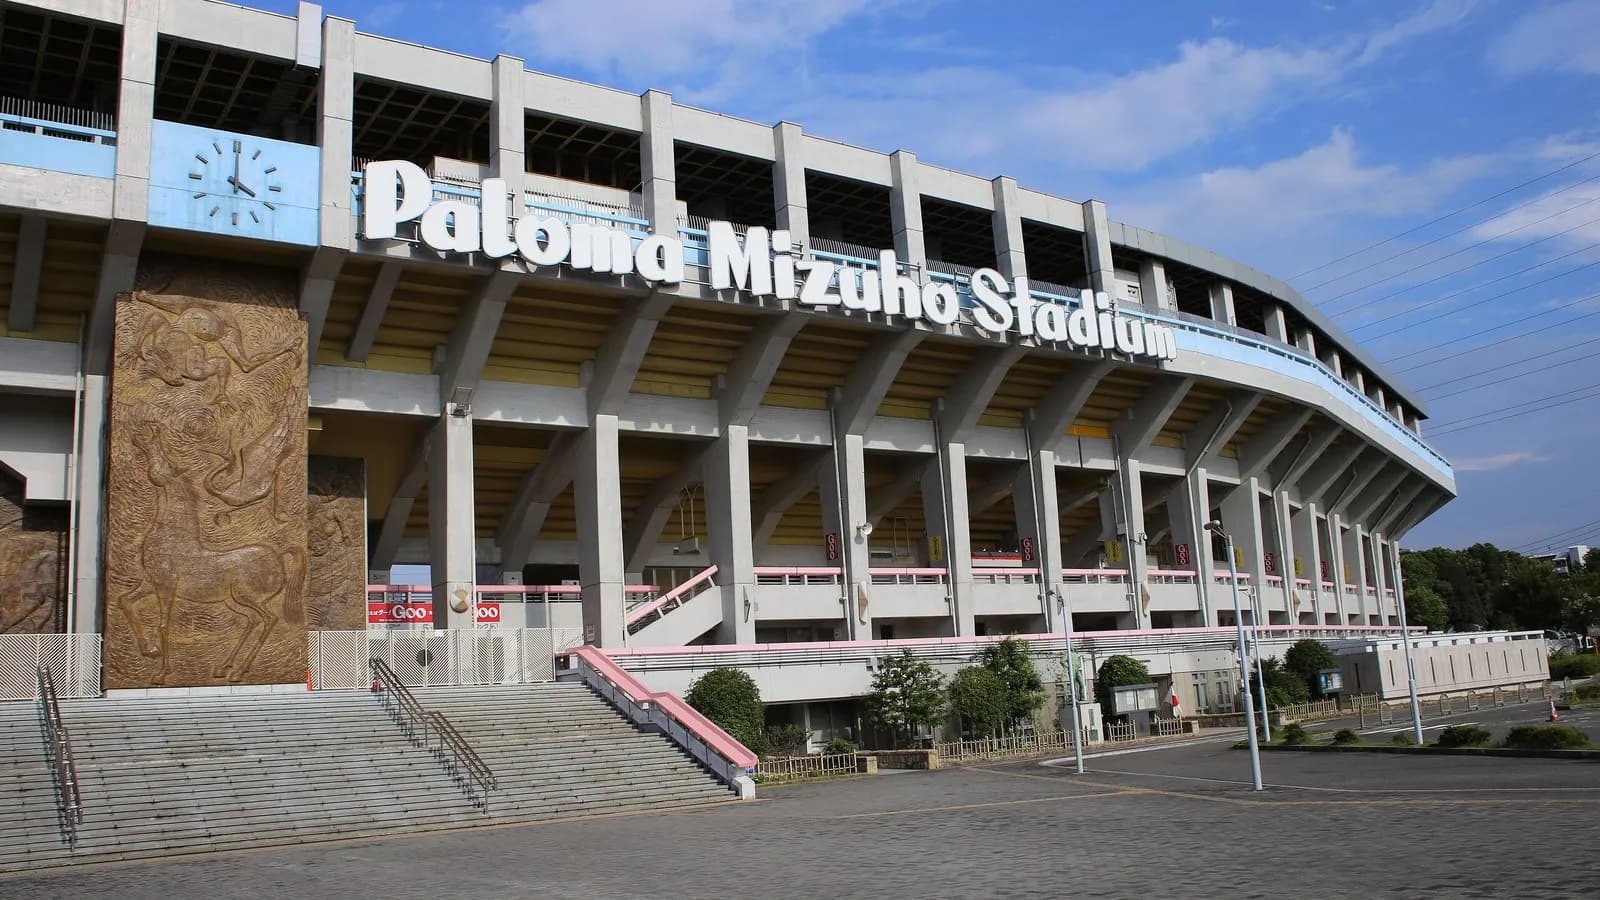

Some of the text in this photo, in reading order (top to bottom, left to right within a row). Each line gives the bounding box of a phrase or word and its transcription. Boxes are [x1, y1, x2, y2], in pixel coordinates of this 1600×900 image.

[365, 159, 1177, 361] Paloma Mizuho Stadium
[392, 604, 427, 619] Goo
[477, 606, 499, 618] oo
